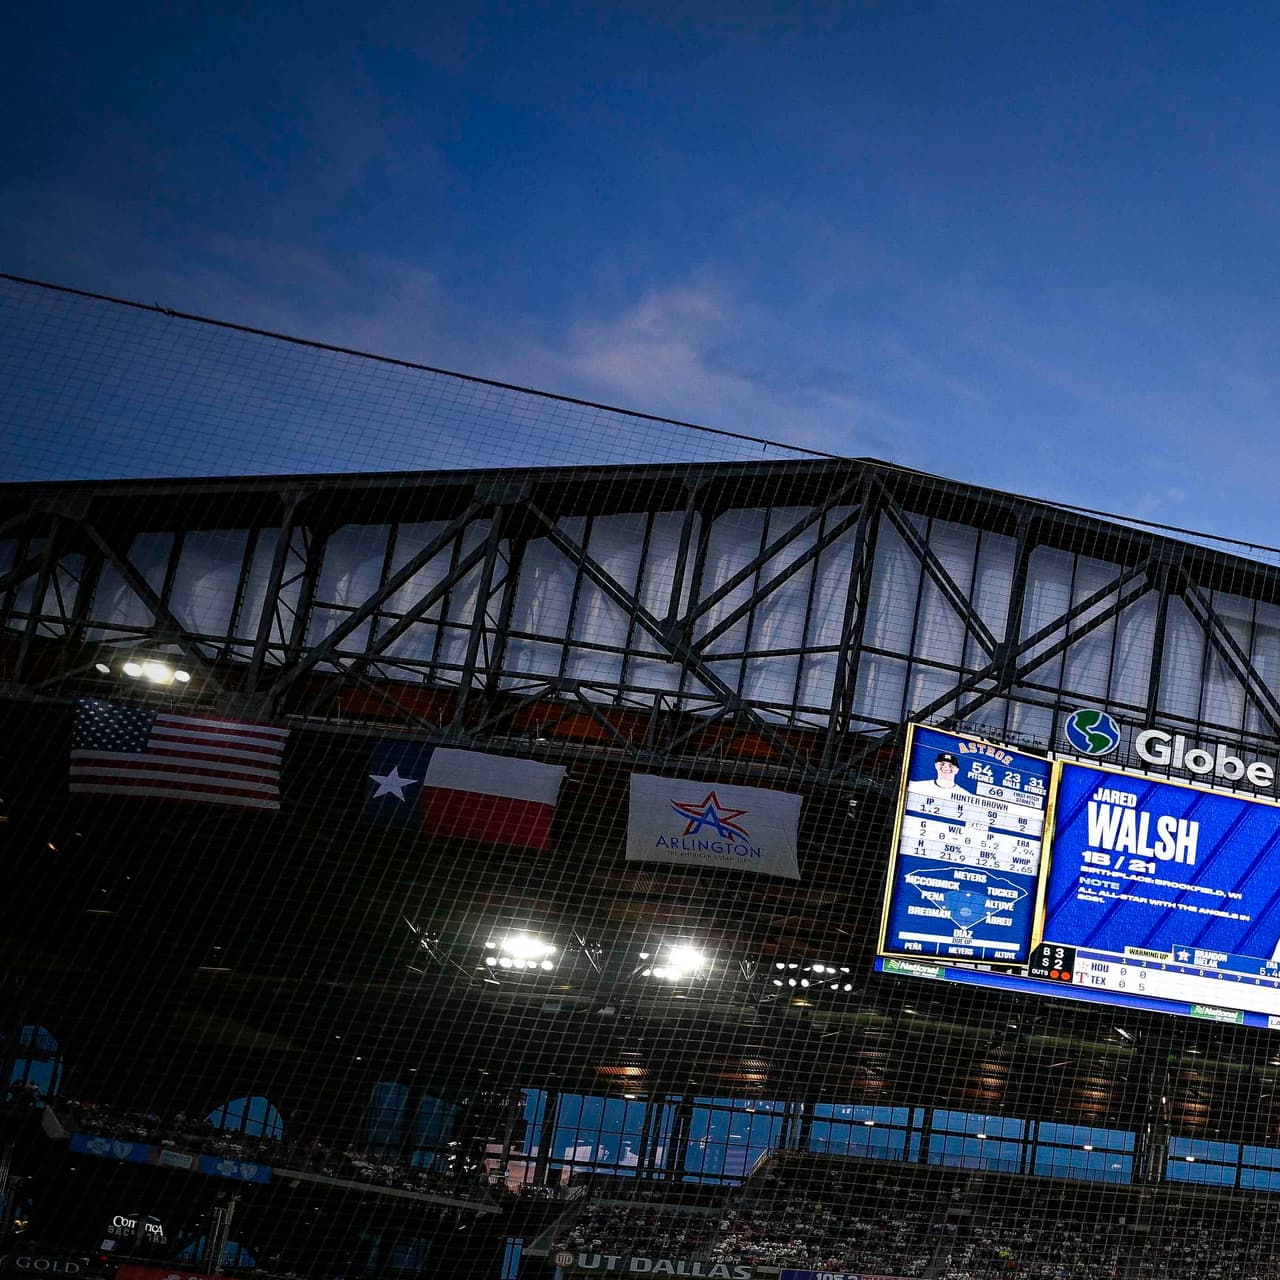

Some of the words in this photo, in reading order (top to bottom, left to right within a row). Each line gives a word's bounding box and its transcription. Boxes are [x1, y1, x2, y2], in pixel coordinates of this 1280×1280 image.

[958, 742, 1014, 766] ASTROS
[1134, 729, 1274, 788] Globe
[971, 762, 993, 776] 54
[1004, 771, 1021, 782] 23
[1029, 777, 1045, 789] 31
[988, 787, 1004, 798] 60
[1093, 787, 1137, 808] JARED
[951, 793, 980, 806] HUNTER
[981, 798, 1009, 812] BROWN
[1087, 801, 1200, 866] WALSH
[655, 835, 761, 859] ARLINGTON
[975, 857, 1000, 868] 12.5
[1082, 851, 1111, 866] 1B
[1128, 859, 1156, 874] 21
[904, 874, 960, 890] MCCORMICK
[953, 870, 987, 883] MEYERS
[1079, 876, 1120, 890] NOTE
[987, 886, 1018, 899] TUCKER
[908, 906, 951, 919] BREGMAN
[985, 900, 1016, 911] ALTUVE
[1149, 898, 1177, 909] WITH
[1177, 903, 1198, 912] THE
[1239, 914, 1251, 922] IN
[1128, 948, 1159, 960] WARMING
[1159, 952, 1169, 960] UP
[1194, 950, 1228, 962] BRANDON
[899, 961, 939, 975] National
[1031, 969, 1049, 977] OUTS
[1205, 1006, 1240, 1021] National
[15, 1255, 81, 1275] GOLD
[578, 1254, 623, 1271] UT
[629, 1256, 752, 1280] DALLAS
